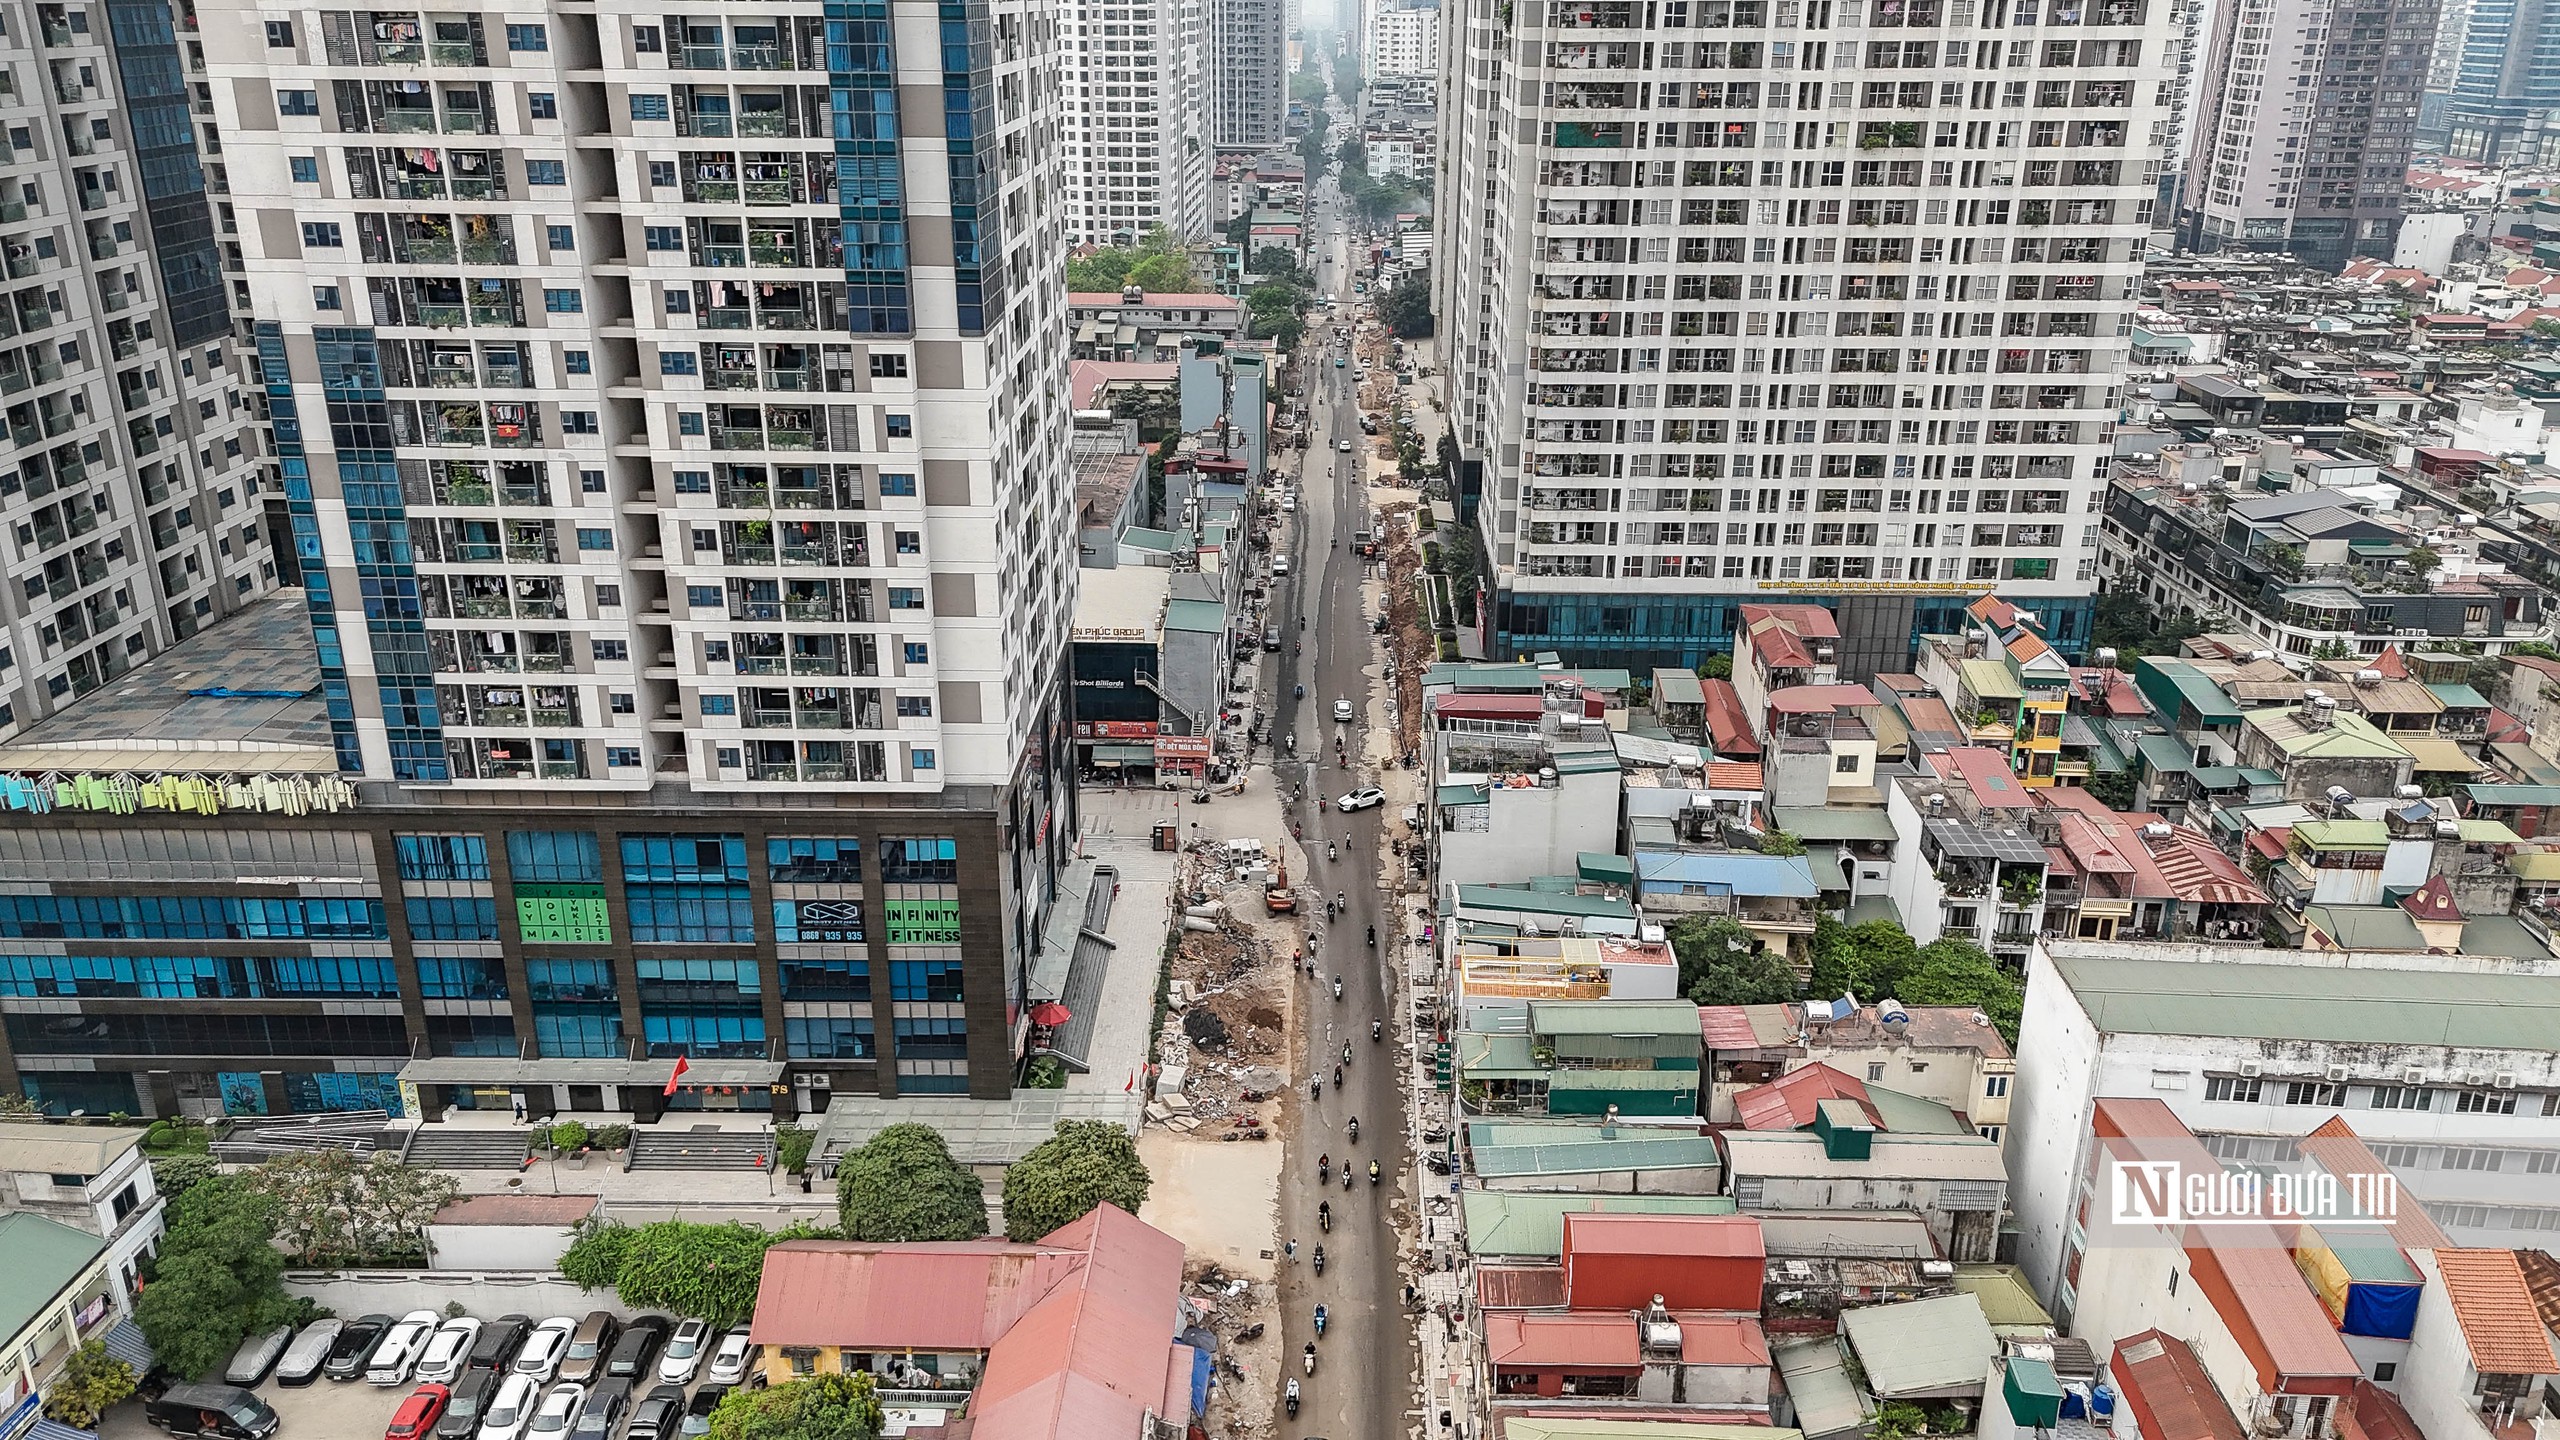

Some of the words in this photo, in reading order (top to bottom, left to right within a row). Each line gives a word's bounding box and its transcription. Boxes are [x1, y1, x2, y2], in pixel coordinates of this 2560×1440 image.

[1085, 626, 1111, 635] PHÚC
[1113, 628, 1145, 636] GROUP
[825, 931, 841, 941] 935
[846, 931, 863, 941] 935
[771, 1084, 788, 1095] FS
